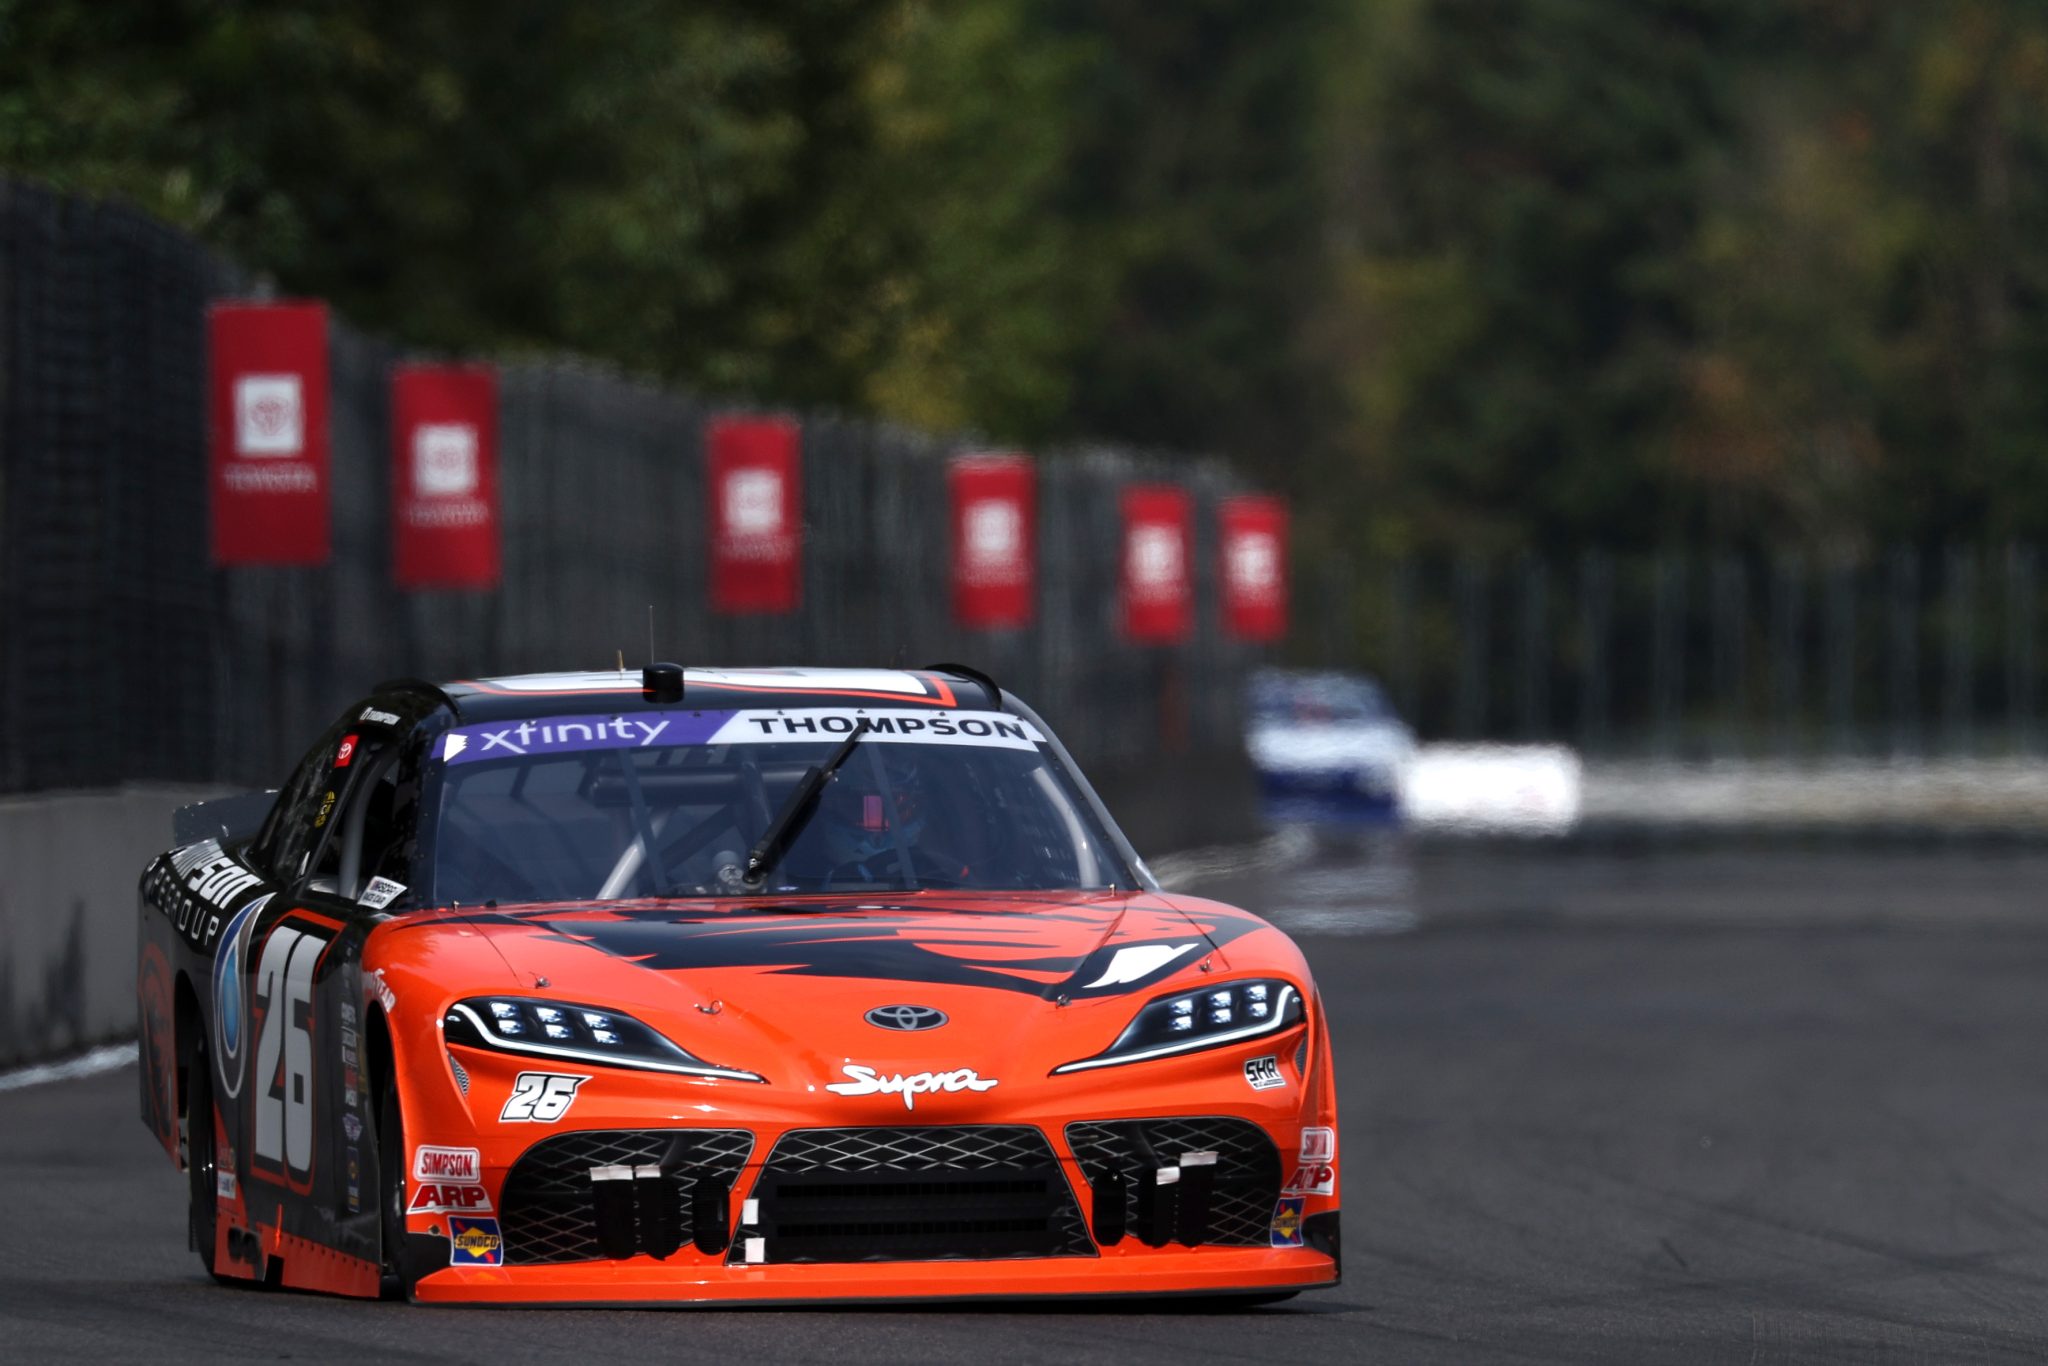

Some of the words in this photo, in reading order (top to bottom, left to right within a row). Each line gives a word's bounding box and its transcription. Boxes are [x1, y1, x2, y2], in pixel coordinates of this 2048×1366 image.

[480, 716, 670, 754] xfinity
[749, 716, 1028, 740] THOMPSON
[255, 925, 328, 1173] 26
[500, 1072, 592, 1123] 26
[826, 1064, 999, 1111] Supra
[421, 1152, 473, 1177] SIMPSON
[410, 1185, 486, 1209] ARP
[455, 1235, 499, 1250] SUNOCO
